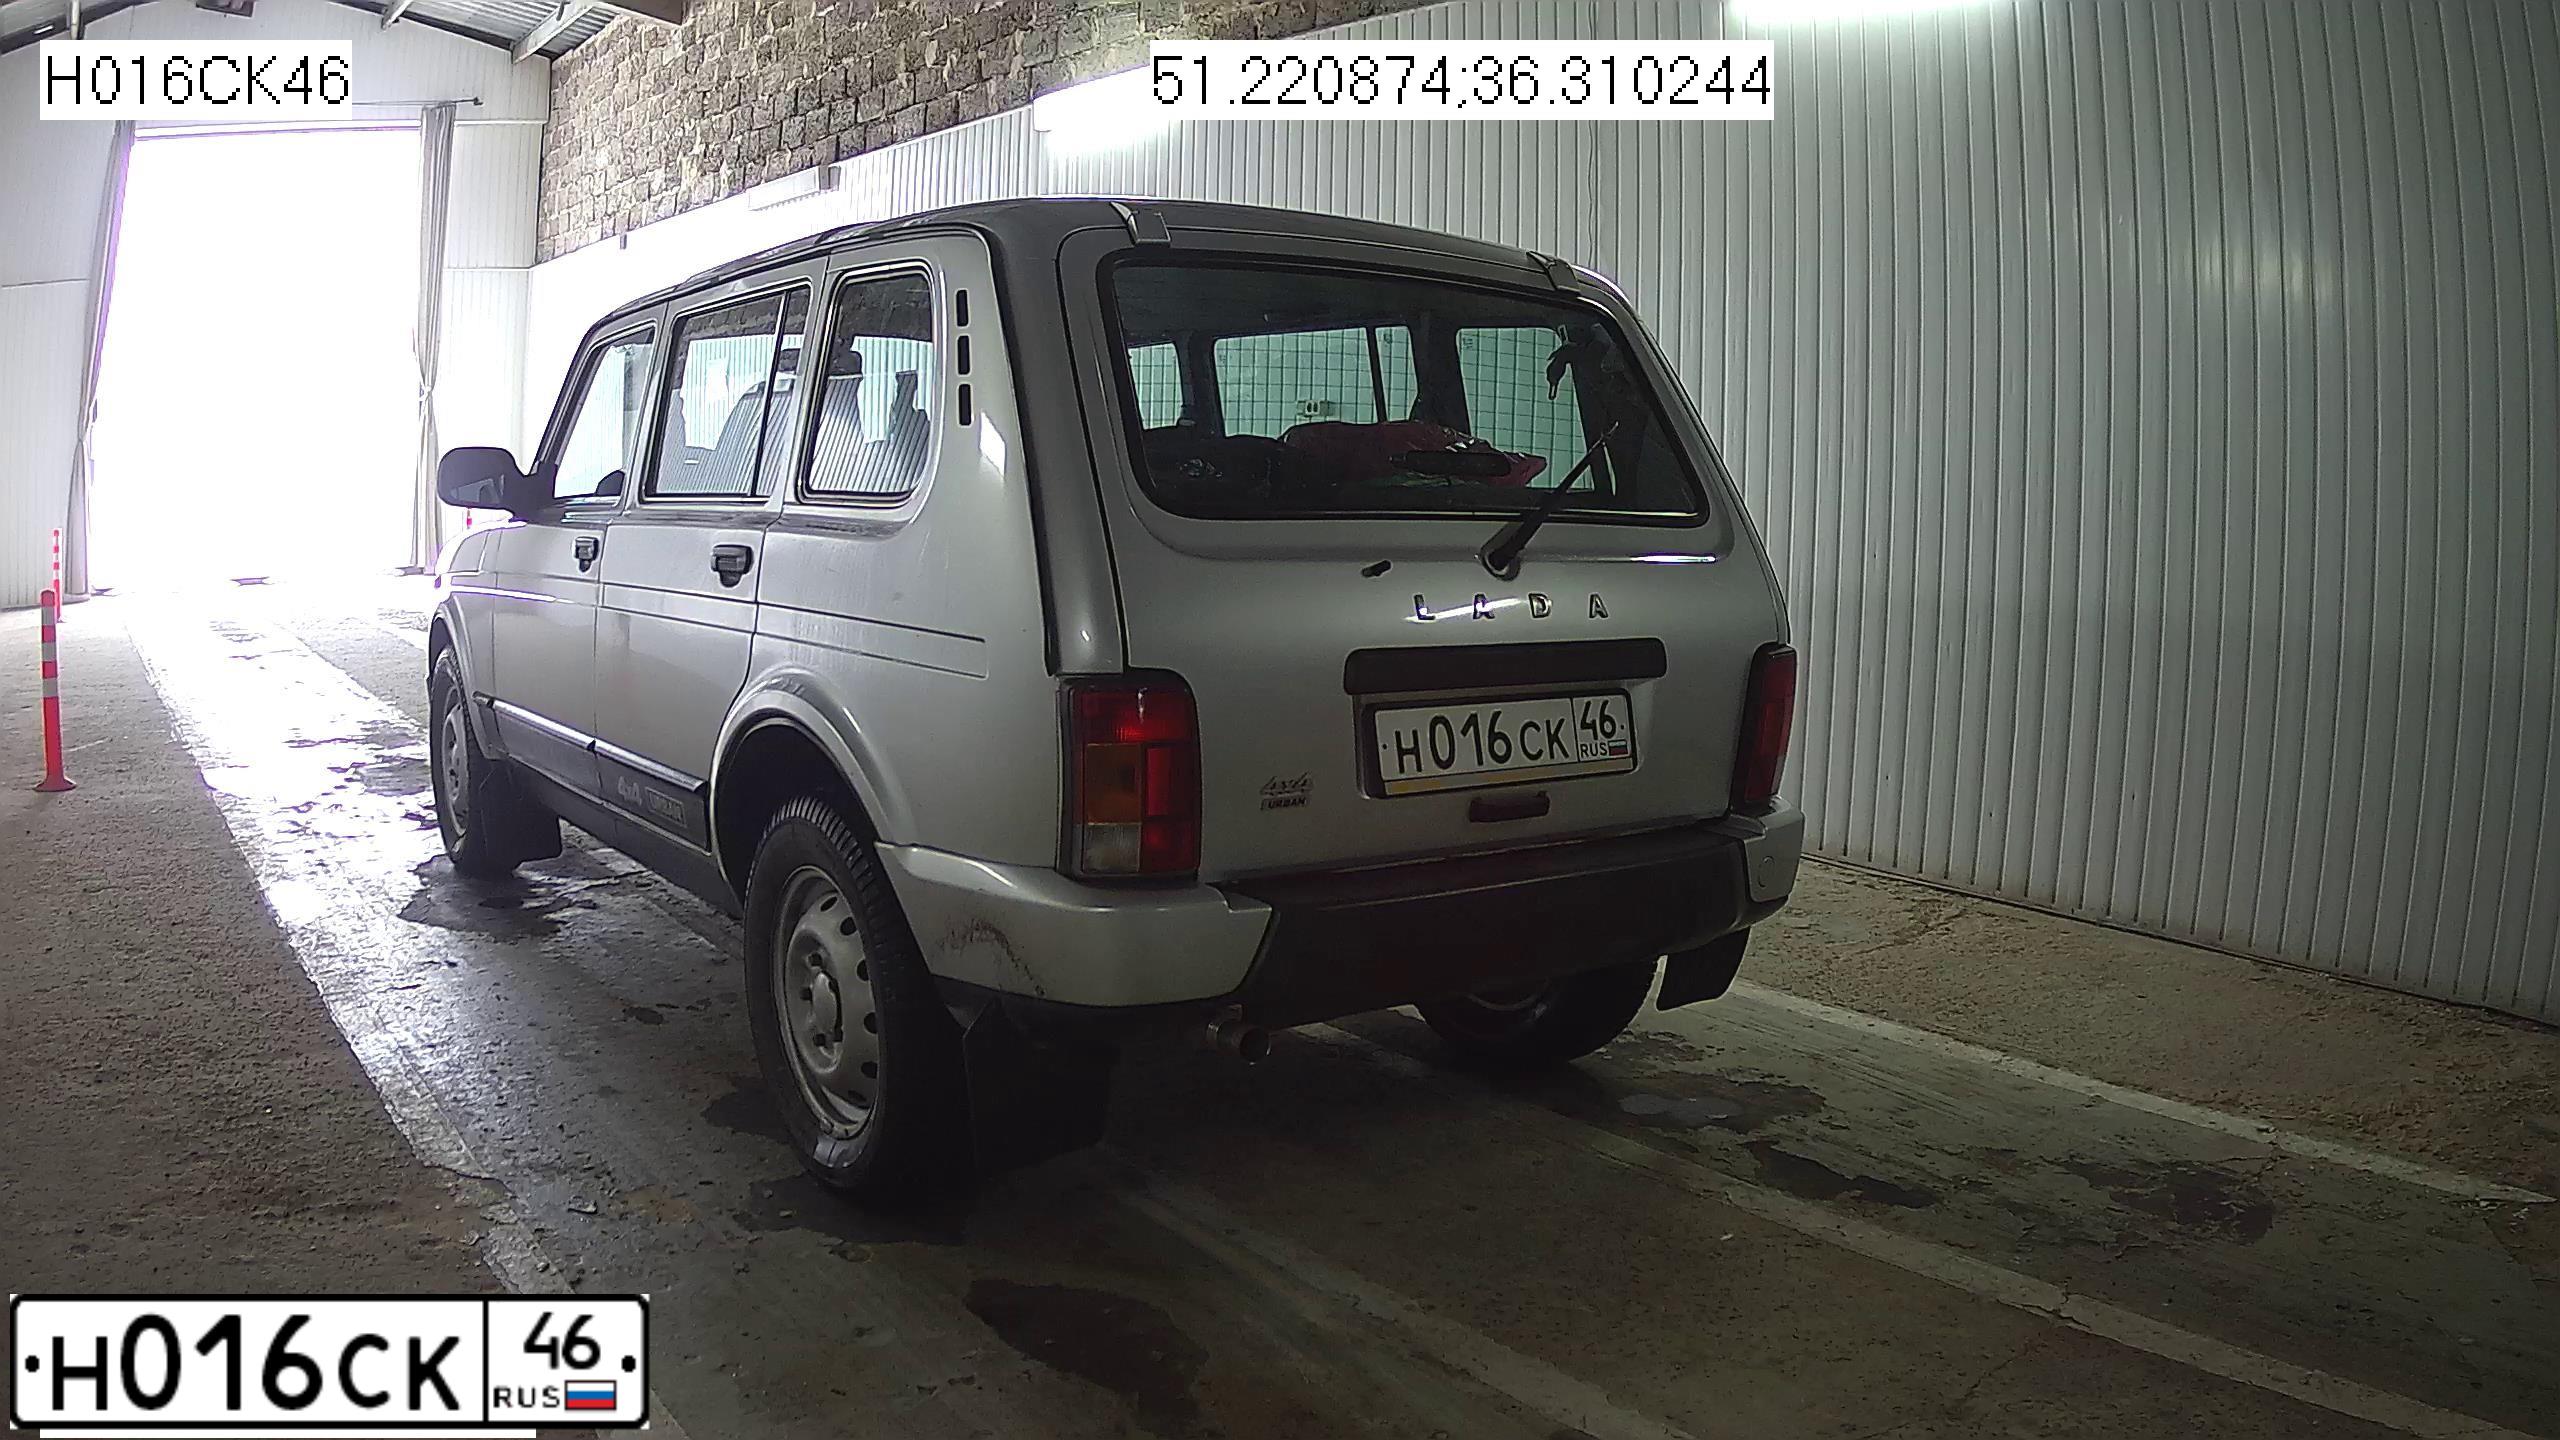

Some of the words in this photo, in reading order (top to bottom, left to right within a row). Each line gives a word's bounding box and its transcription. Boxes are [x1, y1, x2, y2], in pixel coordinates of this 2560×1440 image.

[1414, 594, 1608, 620] LADA
[1580, 700, 1616, 740] 46
[1580, 743, 1607, 757] RUS
[1266, 797, 1307, 810] URBAN
